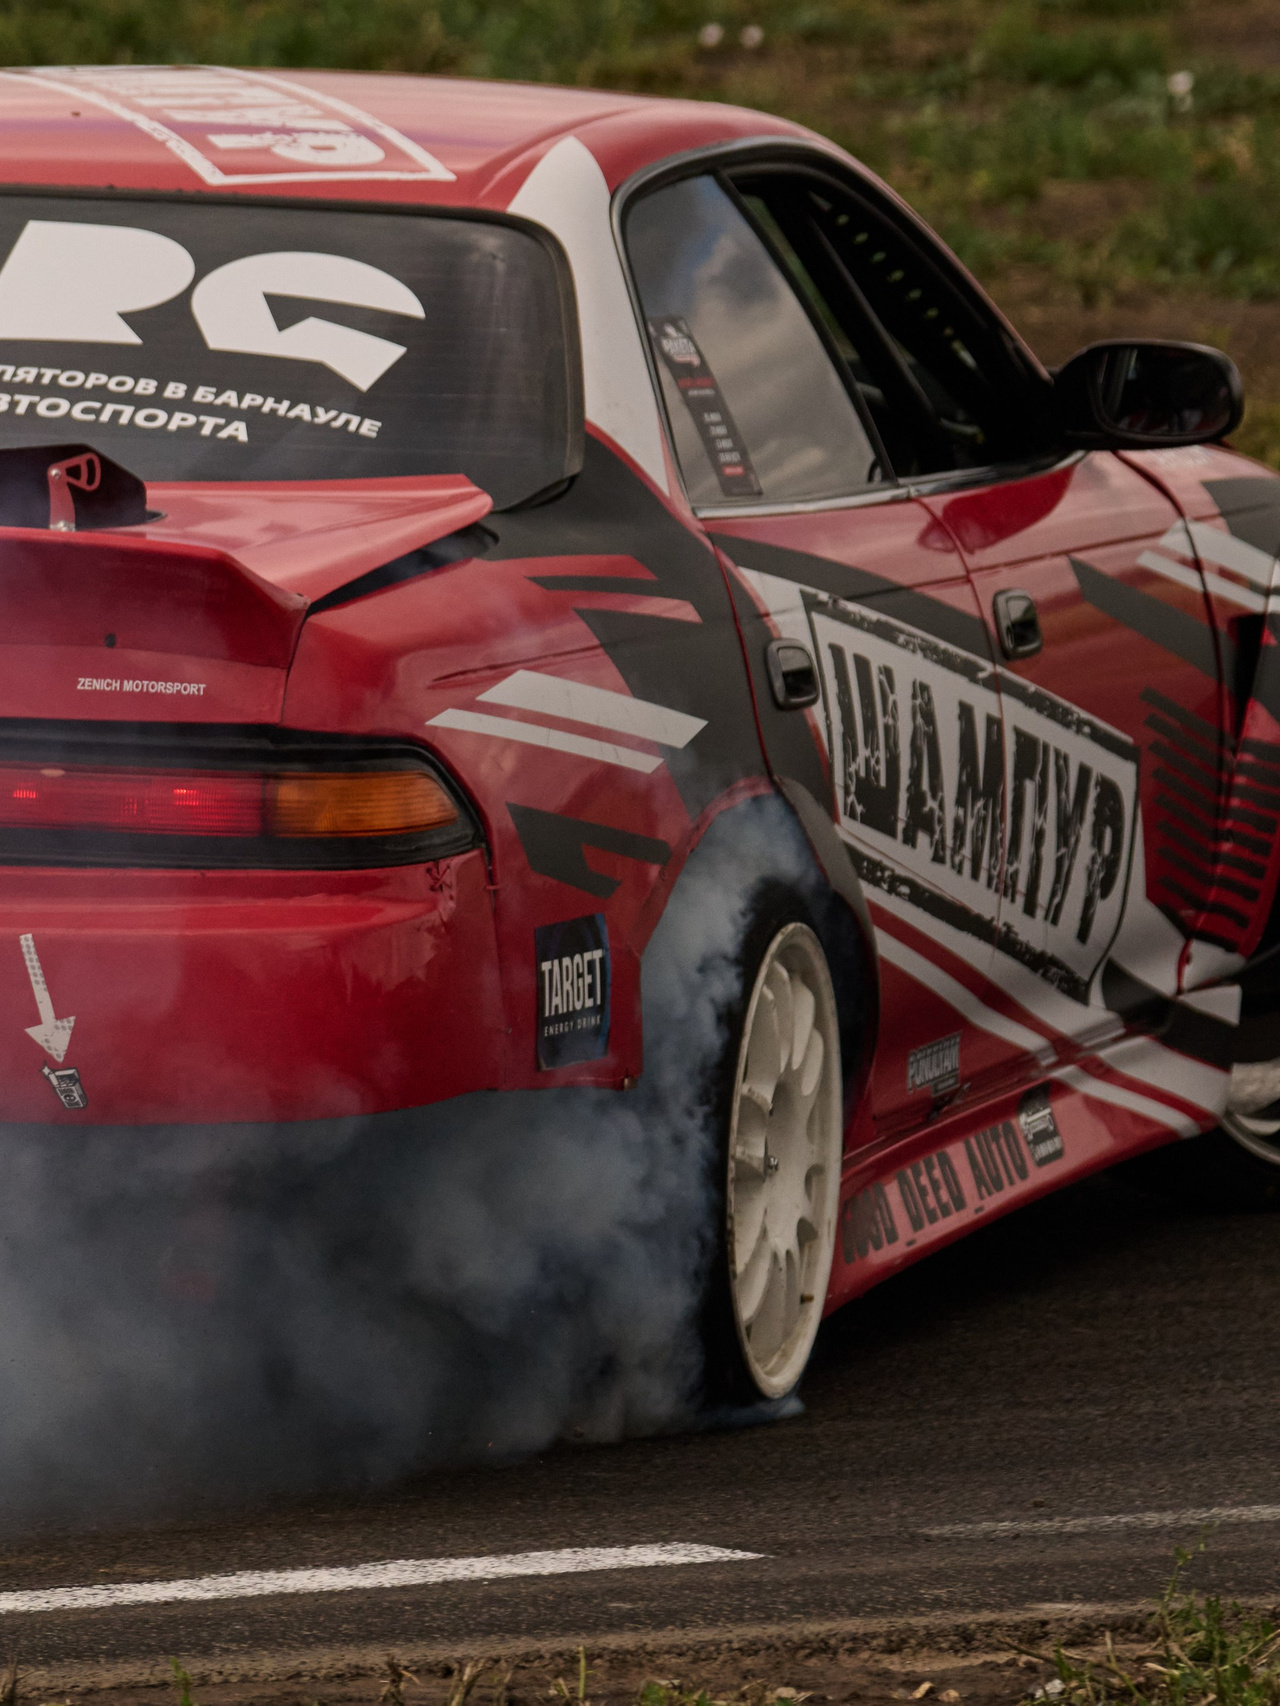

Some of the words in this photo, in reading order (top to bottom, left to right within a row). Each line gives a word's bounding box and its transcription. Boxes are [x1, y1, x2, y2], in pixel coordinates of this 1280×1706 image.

[163, 381, 189, 400] В
[191, 384, 383, 439] БАРНАУЛЕ
[76, 677, 121, 691] ZENICH
[122, 679, 207, 695] MOTORSPORT
[541, 948, 604, 1018] TARGET
[544, 1021, 575, 1037] ENERGY
[577, 1015, 602, 1030] DRINK
